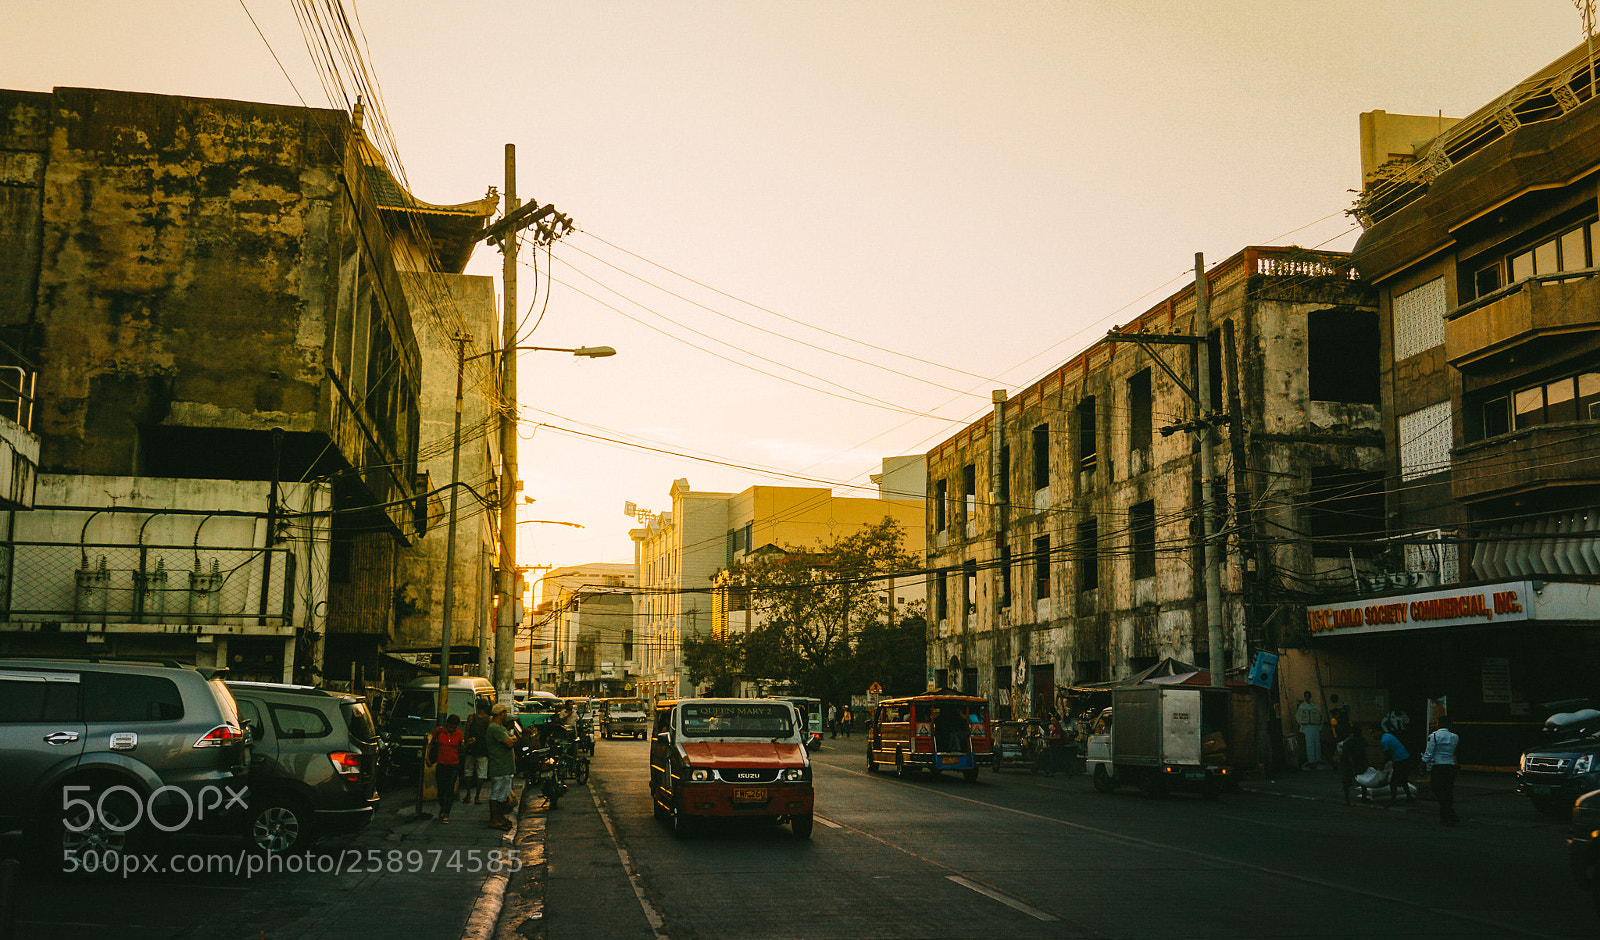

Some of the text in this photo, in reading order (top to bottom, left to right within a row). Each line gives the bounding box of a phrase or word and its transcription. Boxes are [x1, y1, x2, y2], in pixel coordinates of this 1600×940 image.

[1333, 607, 1363, 628] ILOILO
[1365, 602, 1408, 625] SOCIETY
[1410, 593, 1492, 621] COMMERCIAL,
[1493, 590, 1523, 615] INC.
[700, 707, 735, 715] QUEEN
[737, 707, 765, 715] MARY
